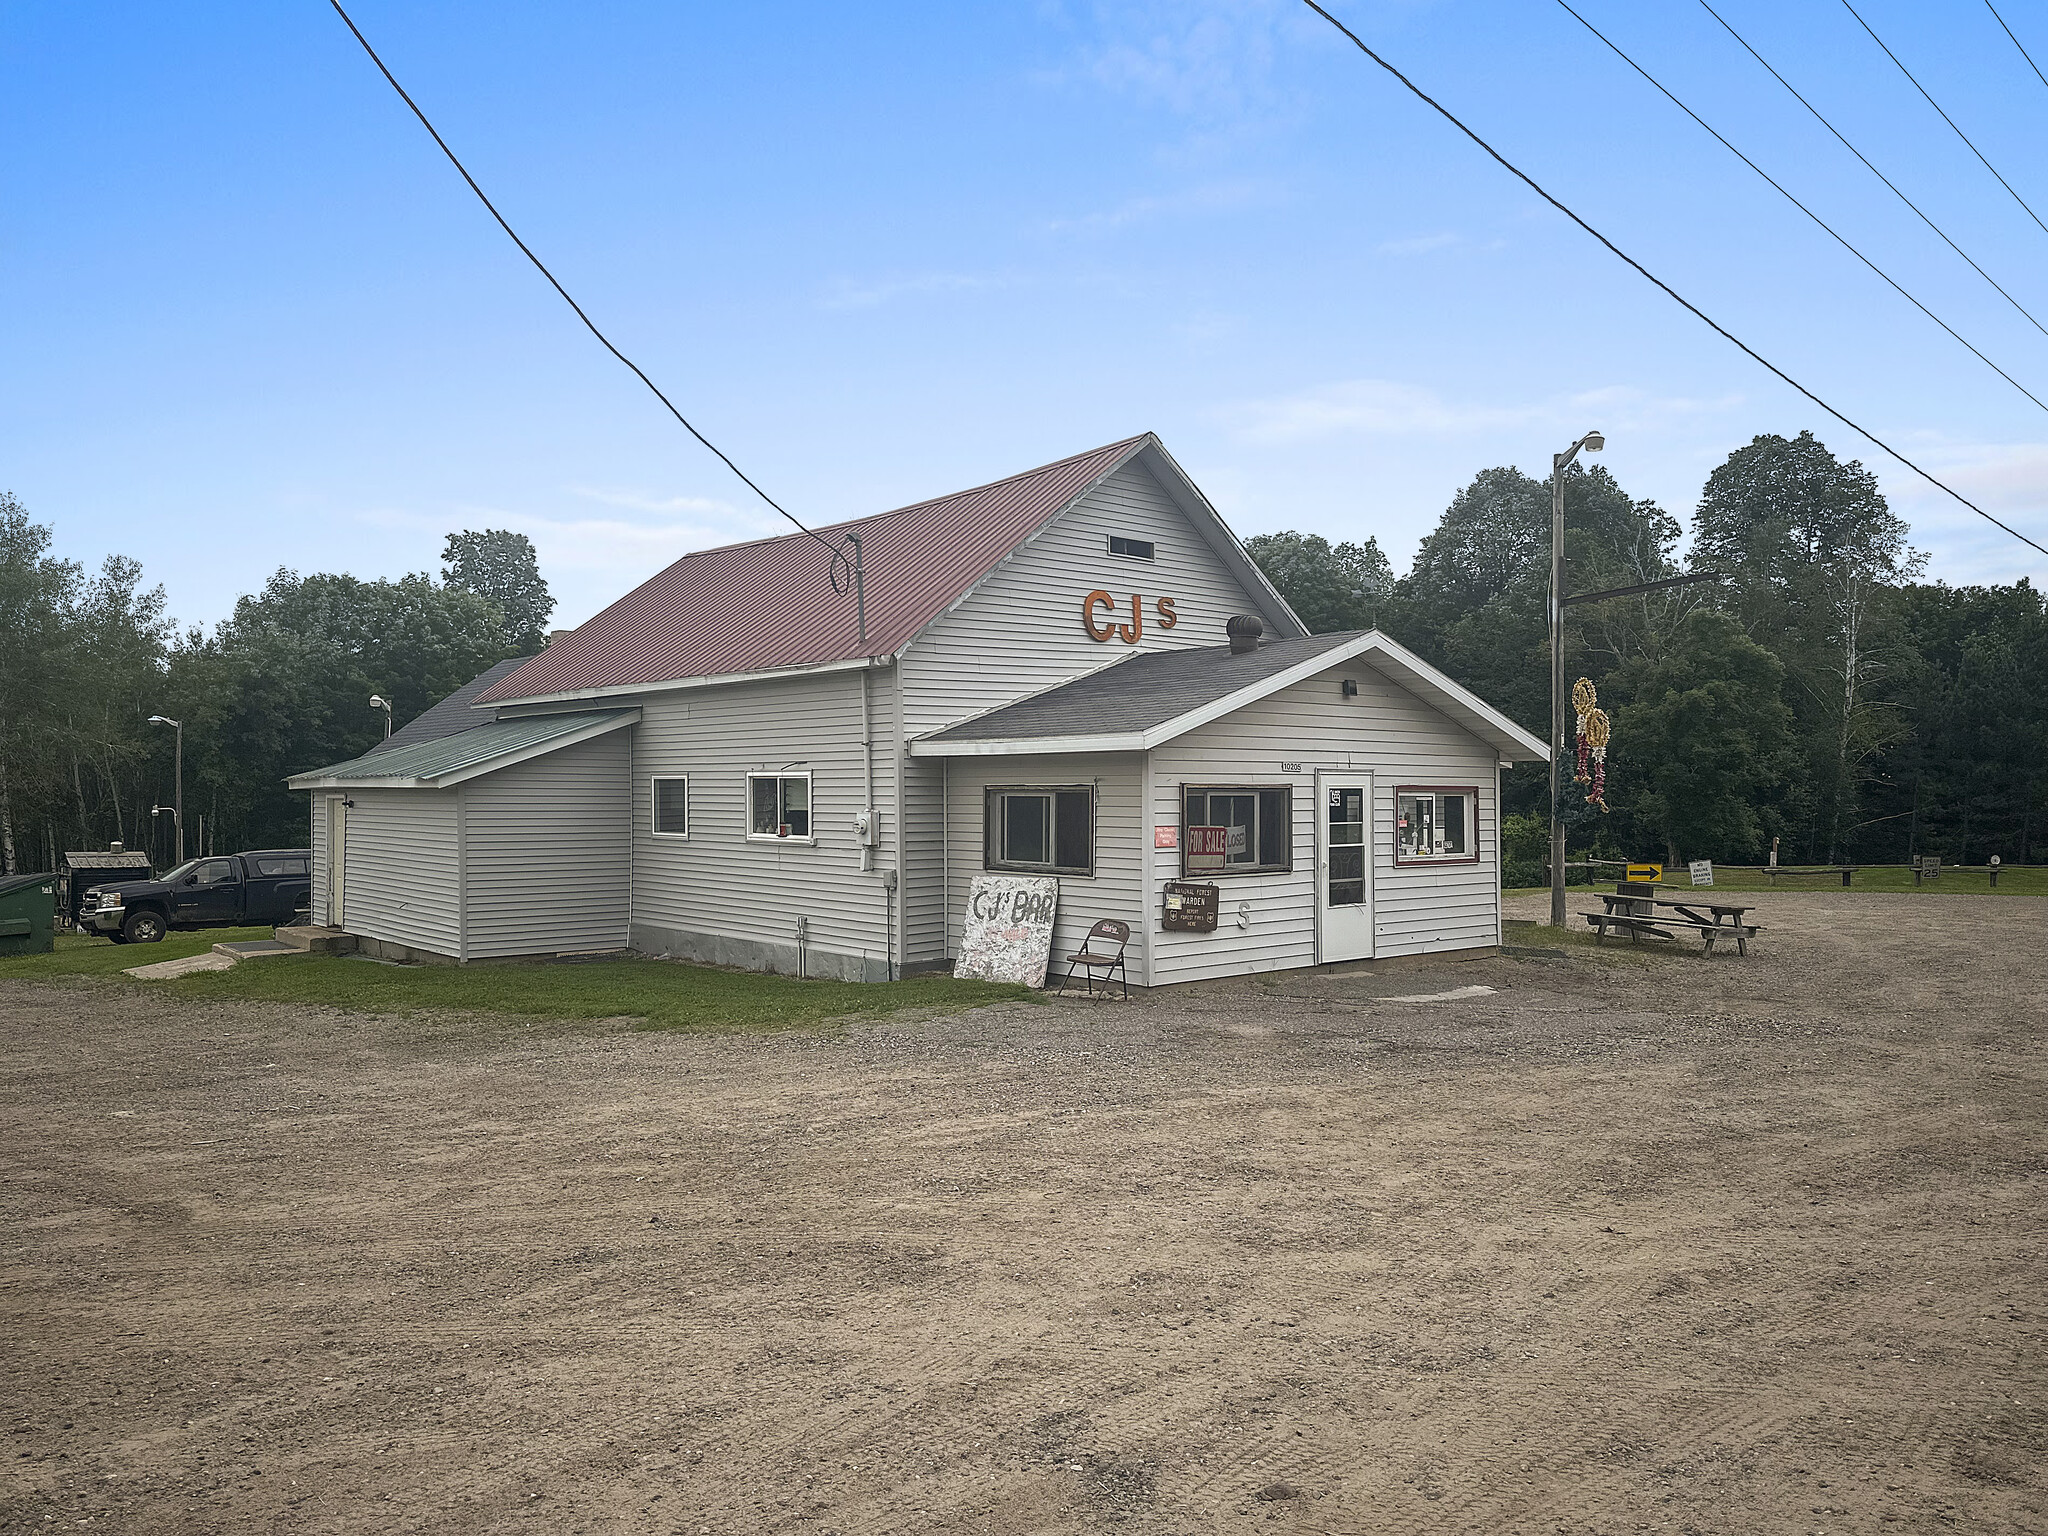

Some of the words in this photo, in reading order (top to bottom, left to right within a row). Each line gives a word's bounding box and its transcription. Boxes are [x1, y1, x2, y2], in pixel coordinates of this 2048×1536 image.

[1189, 830, 1203, 853] FOR
[1205, 830, 1225, 853] SALE
[1227, 832, 1245, 848] LOSED
[1924, 869, 1938, 878] 25
[1011, 890, 1053, 924] BAR
